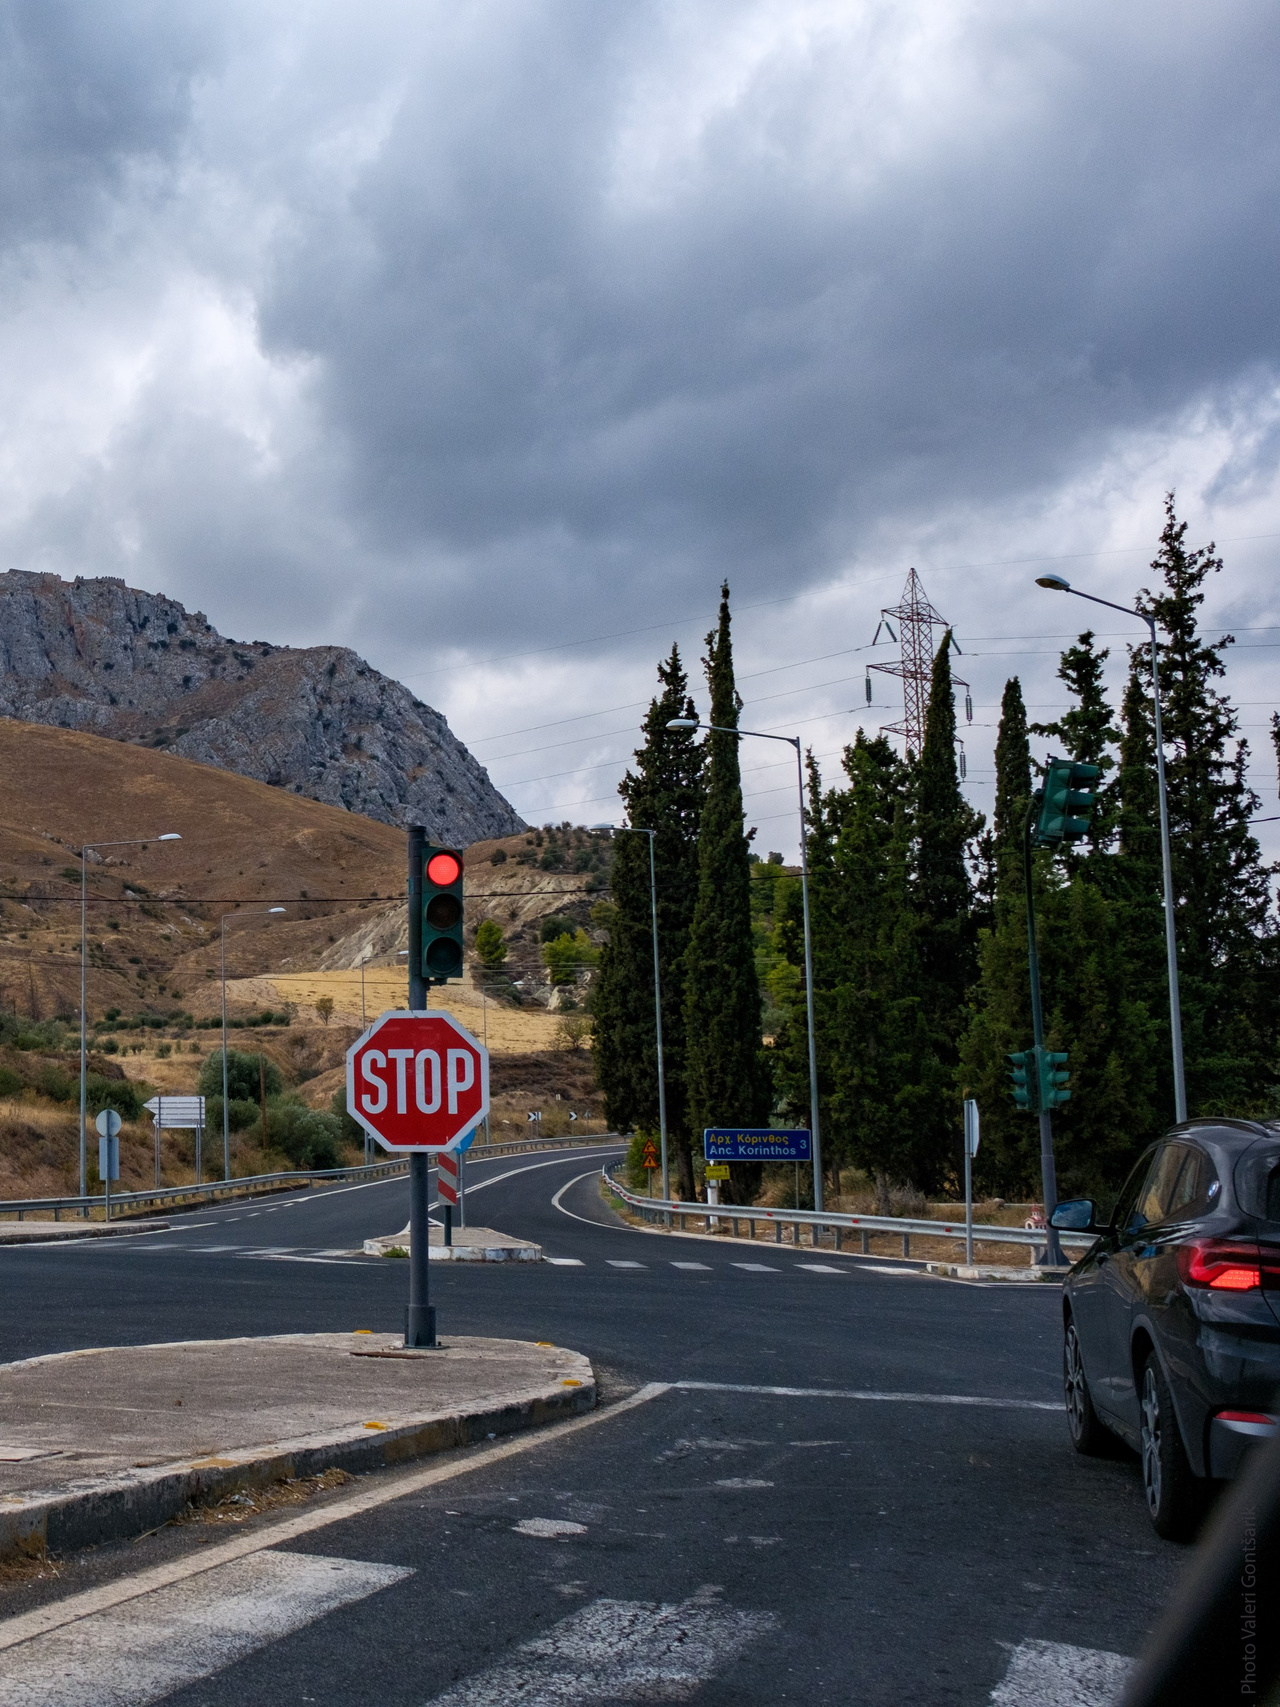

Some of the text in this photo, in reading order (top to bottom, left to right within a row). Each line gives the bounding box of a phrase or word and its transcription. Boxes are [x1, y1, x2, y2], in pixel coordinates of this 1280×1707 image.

[361, 1048, 475, 1115] STOP
[709, 1133, 789, 1146] Αρχ. Κόρινθος
[799, 1139, 807, 1150] 3
[709, 1145, 797, 1155] Anc. Korinthos
